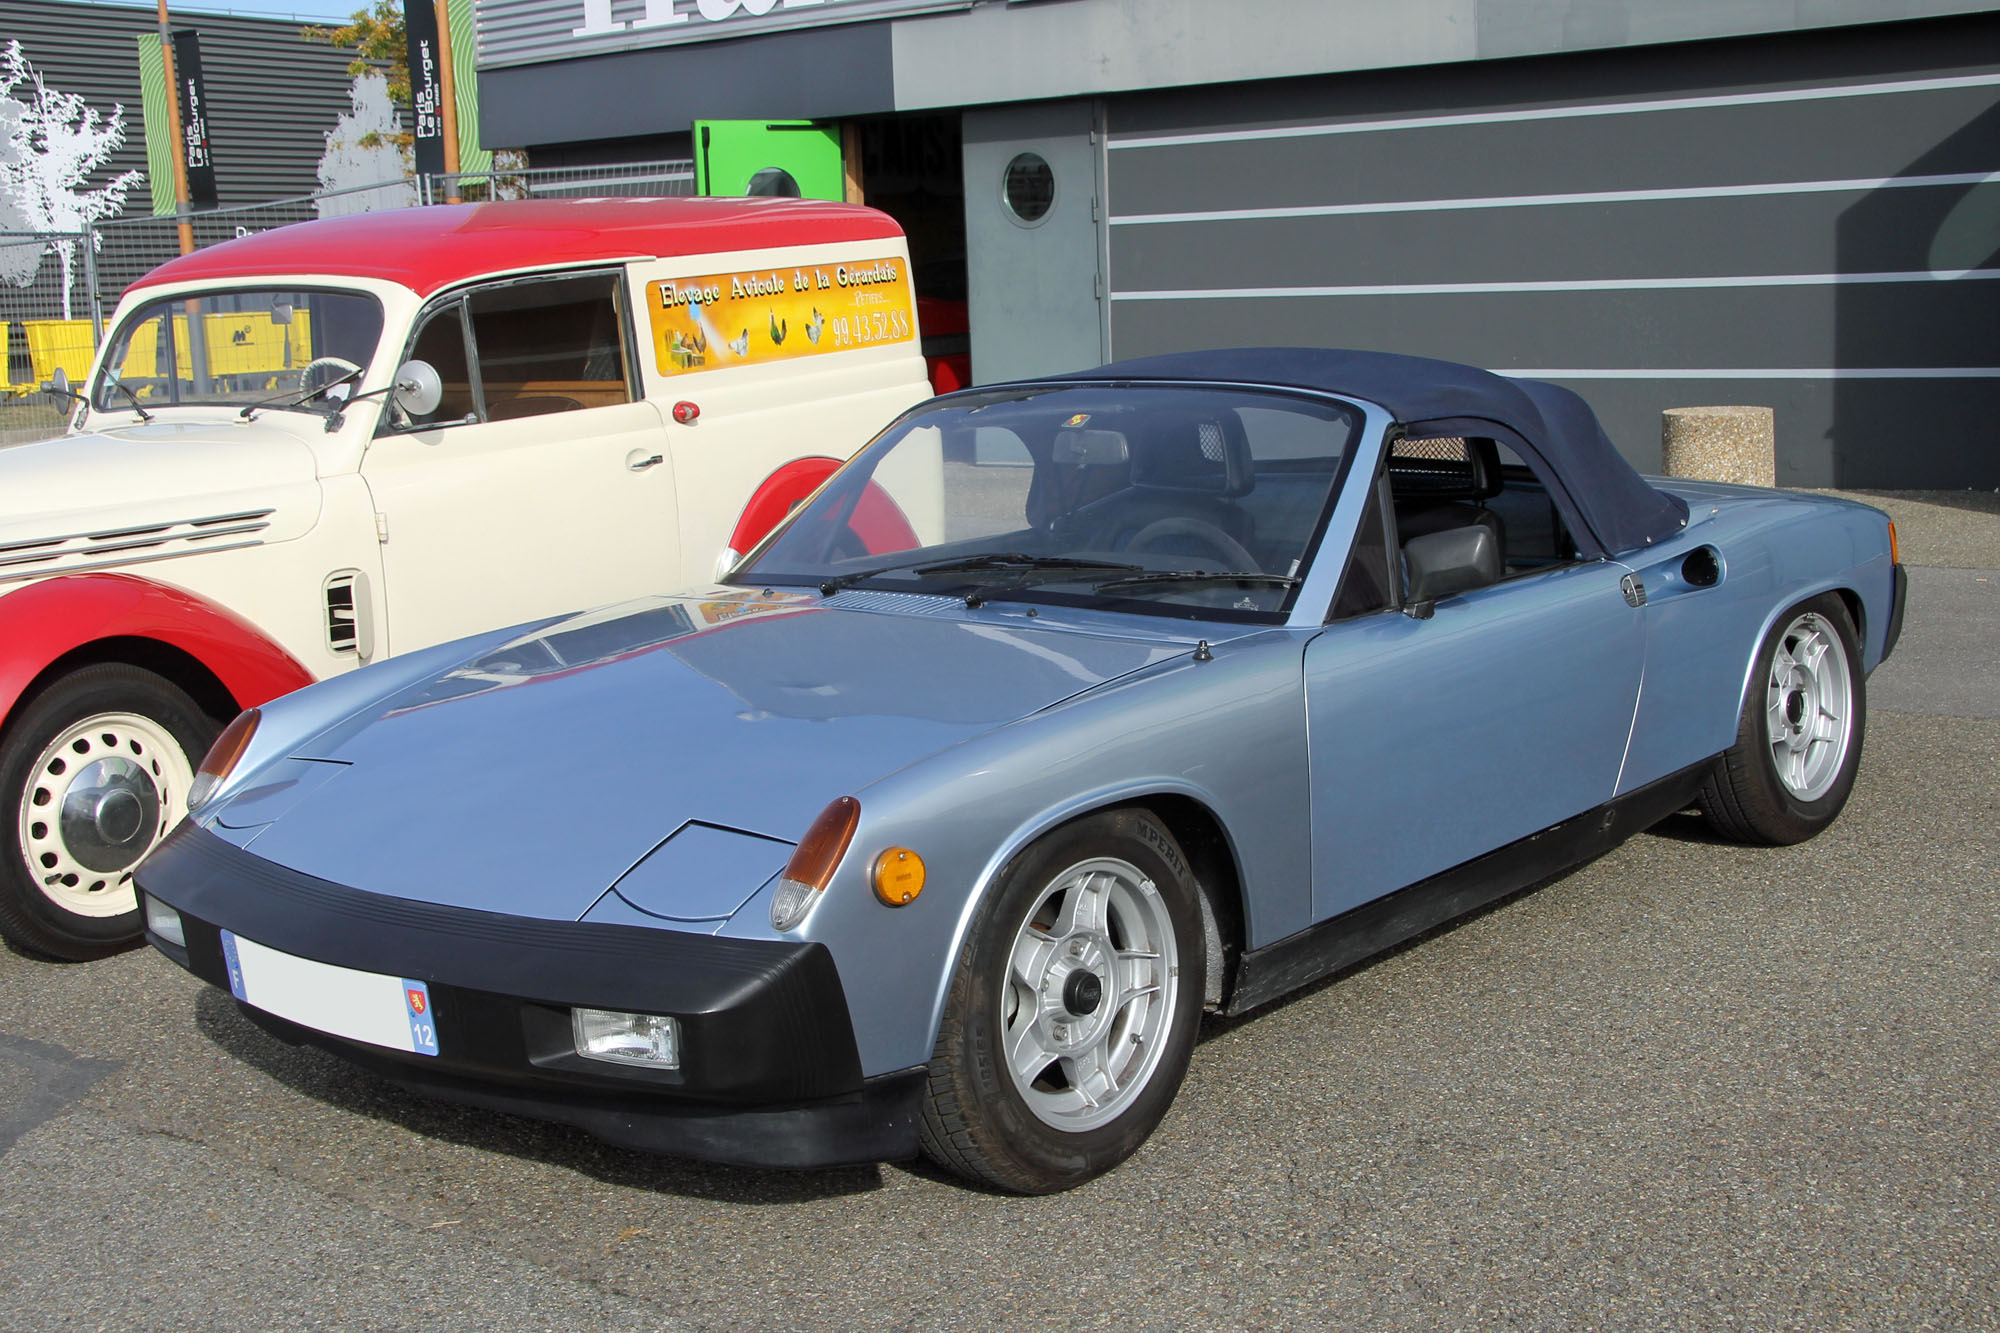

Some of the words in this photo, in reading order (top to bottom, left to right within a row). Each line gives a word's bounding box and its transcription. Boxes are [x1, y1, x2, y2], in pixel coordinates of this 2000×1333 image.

[420, 39, 434, 114] Bourget
[188, 78, 201, 146] Bourget
[416, 91, 426, 138] Paris
[426, 115, 435, 138] Le
[187, 125, 197, 168] Paris
[196, 147, 204, 168] Le
[660, 283, 720, 309] Elevage
[731, 273, 785, 300] Avicole
[794, 269, 809, 292] de
[815, 269, 831, 290] la
[833, 309, 909, 347] 99.43.52.88
[414, 1024, 434, 1047] 12
